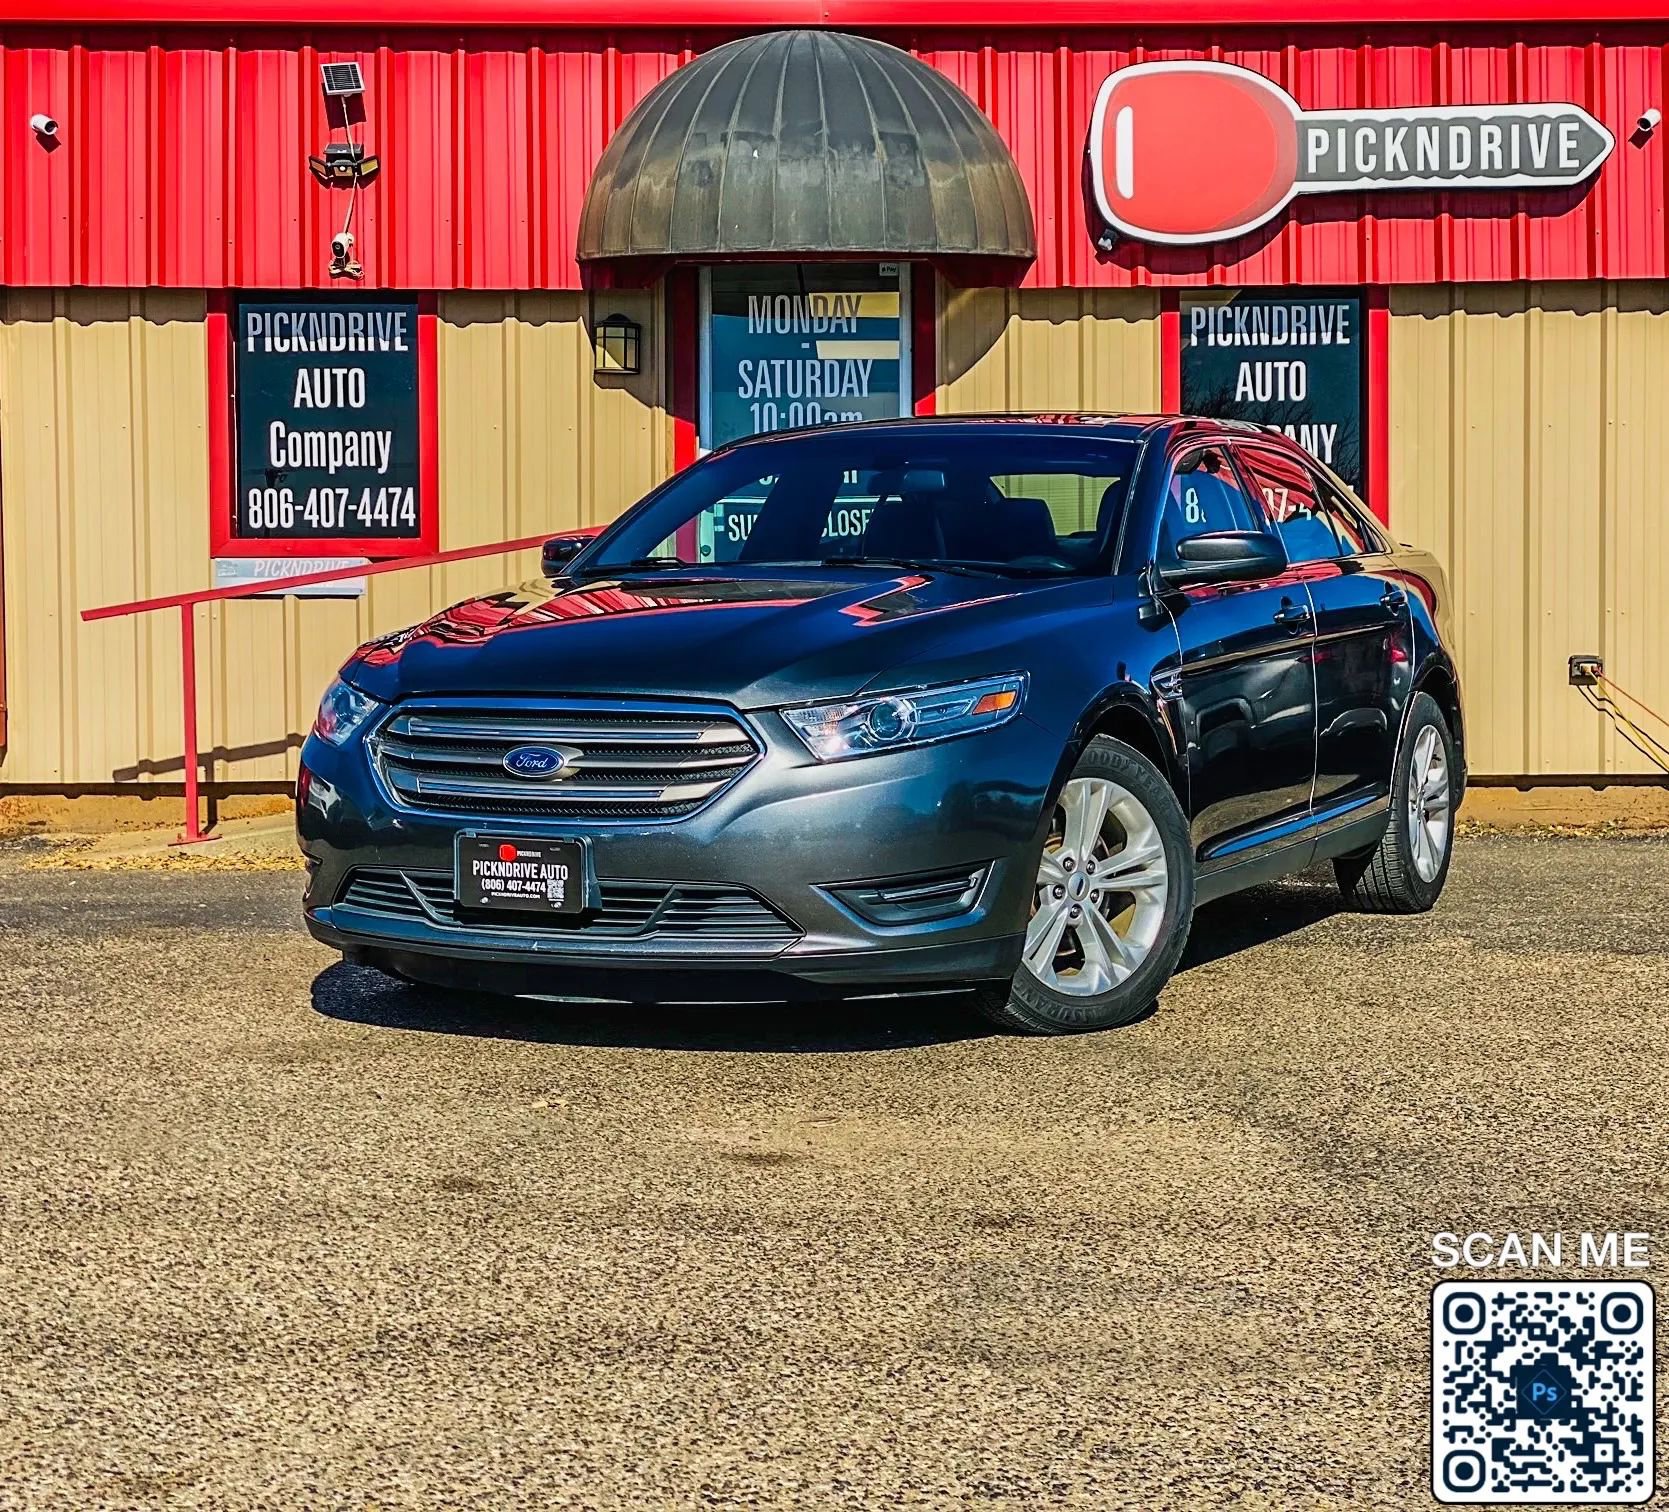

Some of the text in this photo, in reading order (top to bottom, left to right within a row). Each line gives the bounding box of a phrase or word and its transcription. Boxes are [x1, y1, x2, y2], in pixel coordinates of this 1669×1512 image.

[1307, 123, 1580, 172] PICKNDRIVE
[247, 312, 408, 352] PICKNDRIVE
[748, 295, 863, 334] MONDAY
[1191, 305, 1350, 346] PICKNDRIVE
[293, 367, 366, 408] AUTO
[738, 359, 873, 399] SATURDAY
[1234, 360, 1308, 402] AUTO
[269, 421, 392, 474] Company
[249, 487, 416, 528] 806-407-4474
[515, 752, 549, 769] Ford
[472, 859, 570, 881] PICKNDRIVE AUTO
[481, 878, 547, 893] (806) 407-4474
